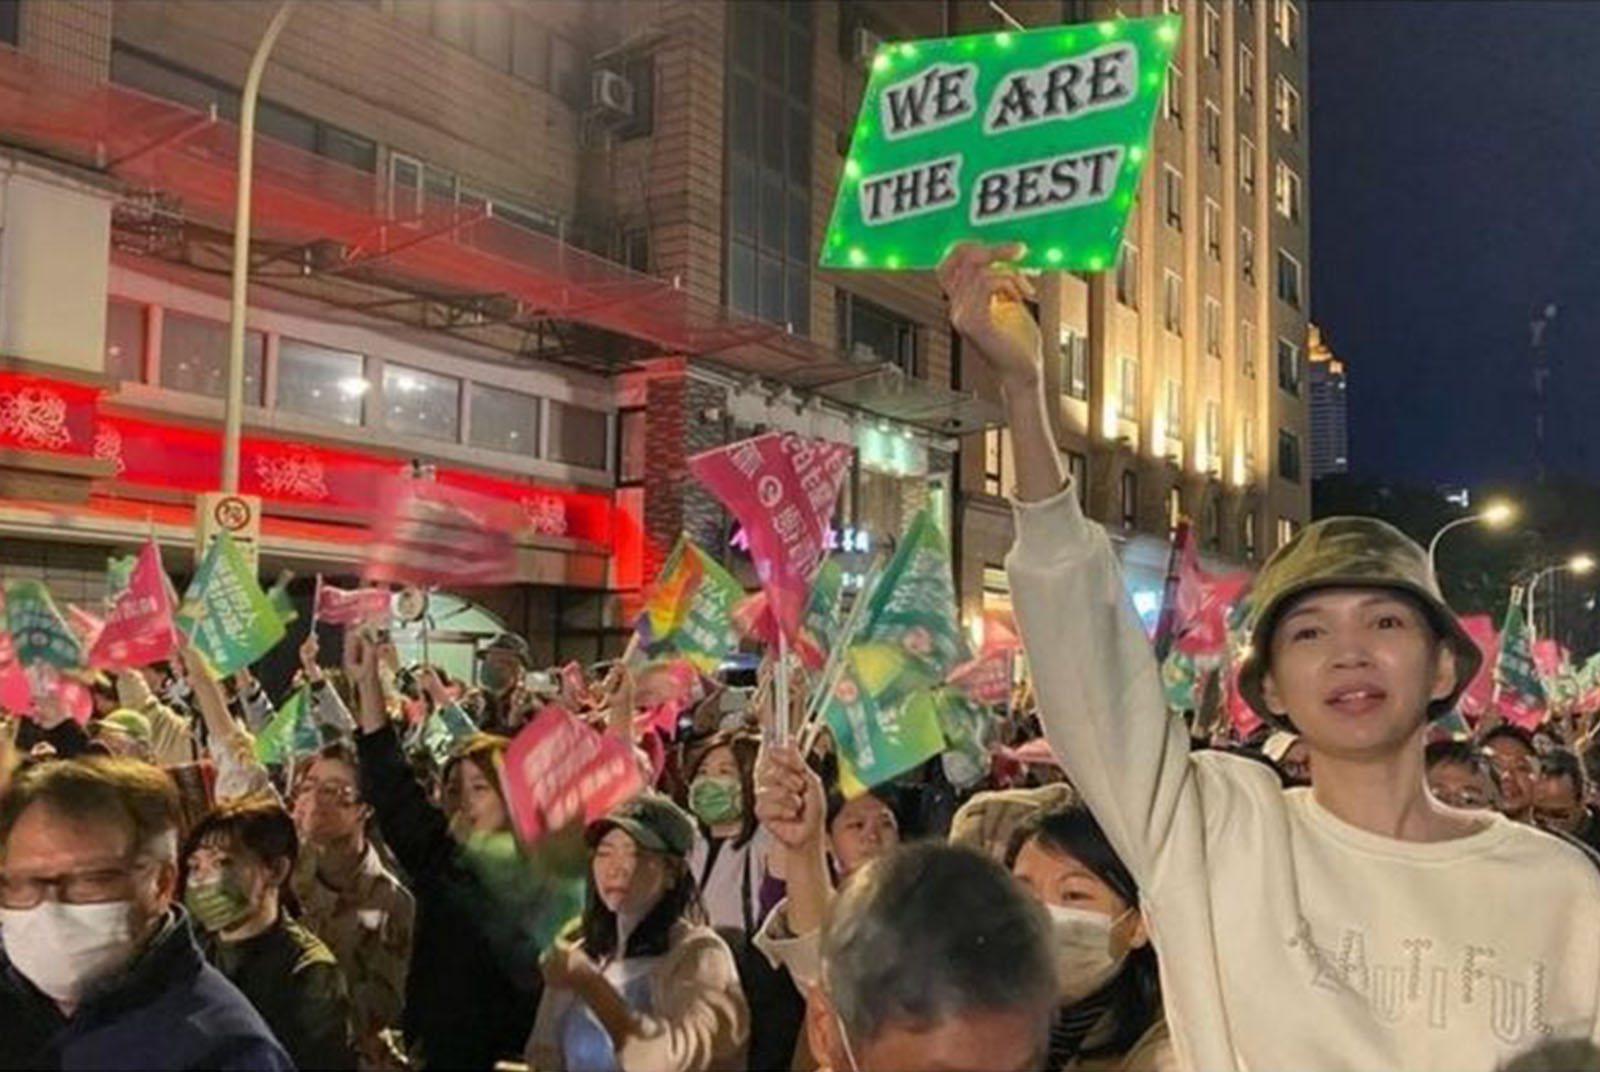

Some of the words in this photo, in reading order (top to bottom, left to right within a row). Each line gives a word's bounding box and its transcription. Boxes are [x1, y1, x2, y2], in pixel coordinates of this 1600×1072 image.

[886, 67, 970, 132] WE
[990, 48, 1131, 131] ARE
[863, 160, 955, 220] THE
[975, 150, 1118, 218] BEST
